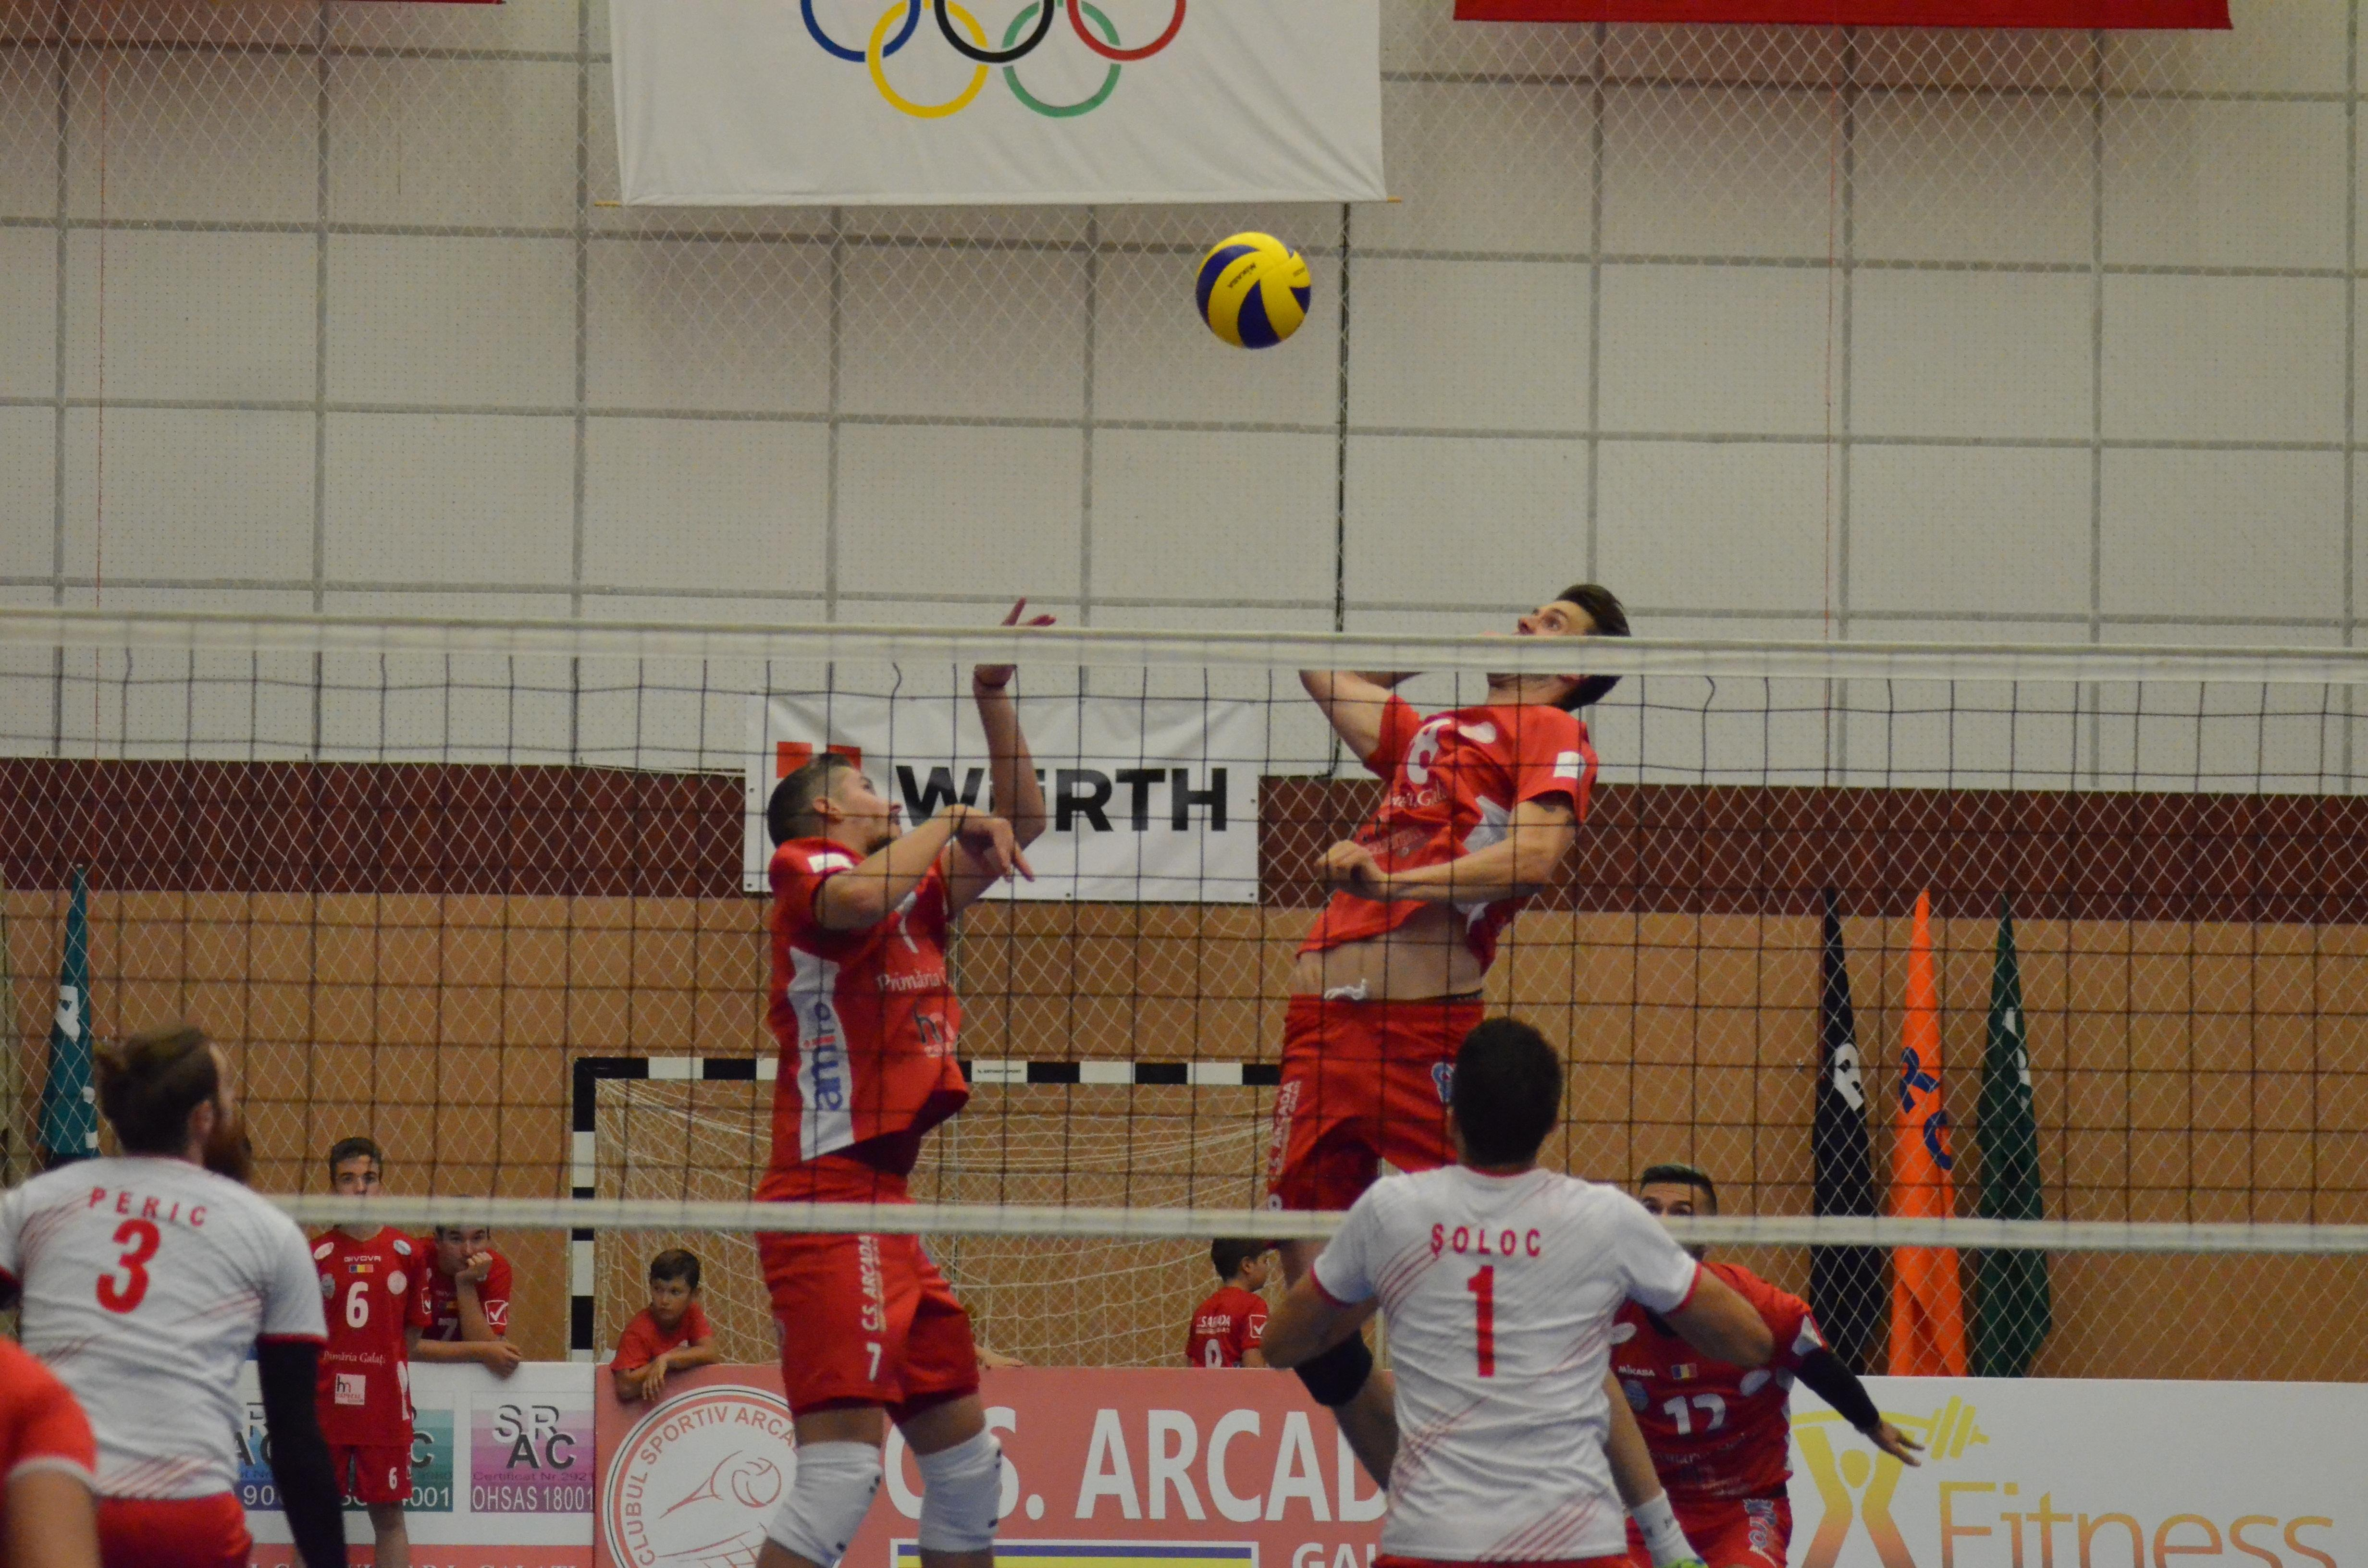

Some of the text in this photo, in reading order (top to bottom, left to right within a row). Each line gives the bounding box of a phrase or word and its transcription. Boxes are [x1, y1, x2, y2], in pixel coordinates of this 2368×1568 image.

[896, 765, 1228, 832] WRTH
[89, 1187, 207, 1226] PERIC
[1431, 1224, 1541, 1257] SOLOC
[96, 1219, 160, 1313] 3
[346, 1281, 369, 1328] 6
[1468, 1265, 1494, 1377] 1
[865, 1341, 882, 1382] 7
[492, 1404, 559, 1443] SR
[506, 1432, 577, 1470] AC
[1074, 1408, 1389, 1523] ARCAD
[389, 1467, 397, 1490] 6
[472, 1485, 593, 1511] OHSAS 18001
[626, 1406, 795, 1567] CLUBUL SPORTIV ARCA
[1939, 1481, 2338, 1568] Fitness
[1292, 1542, 1376, 1568] GA
